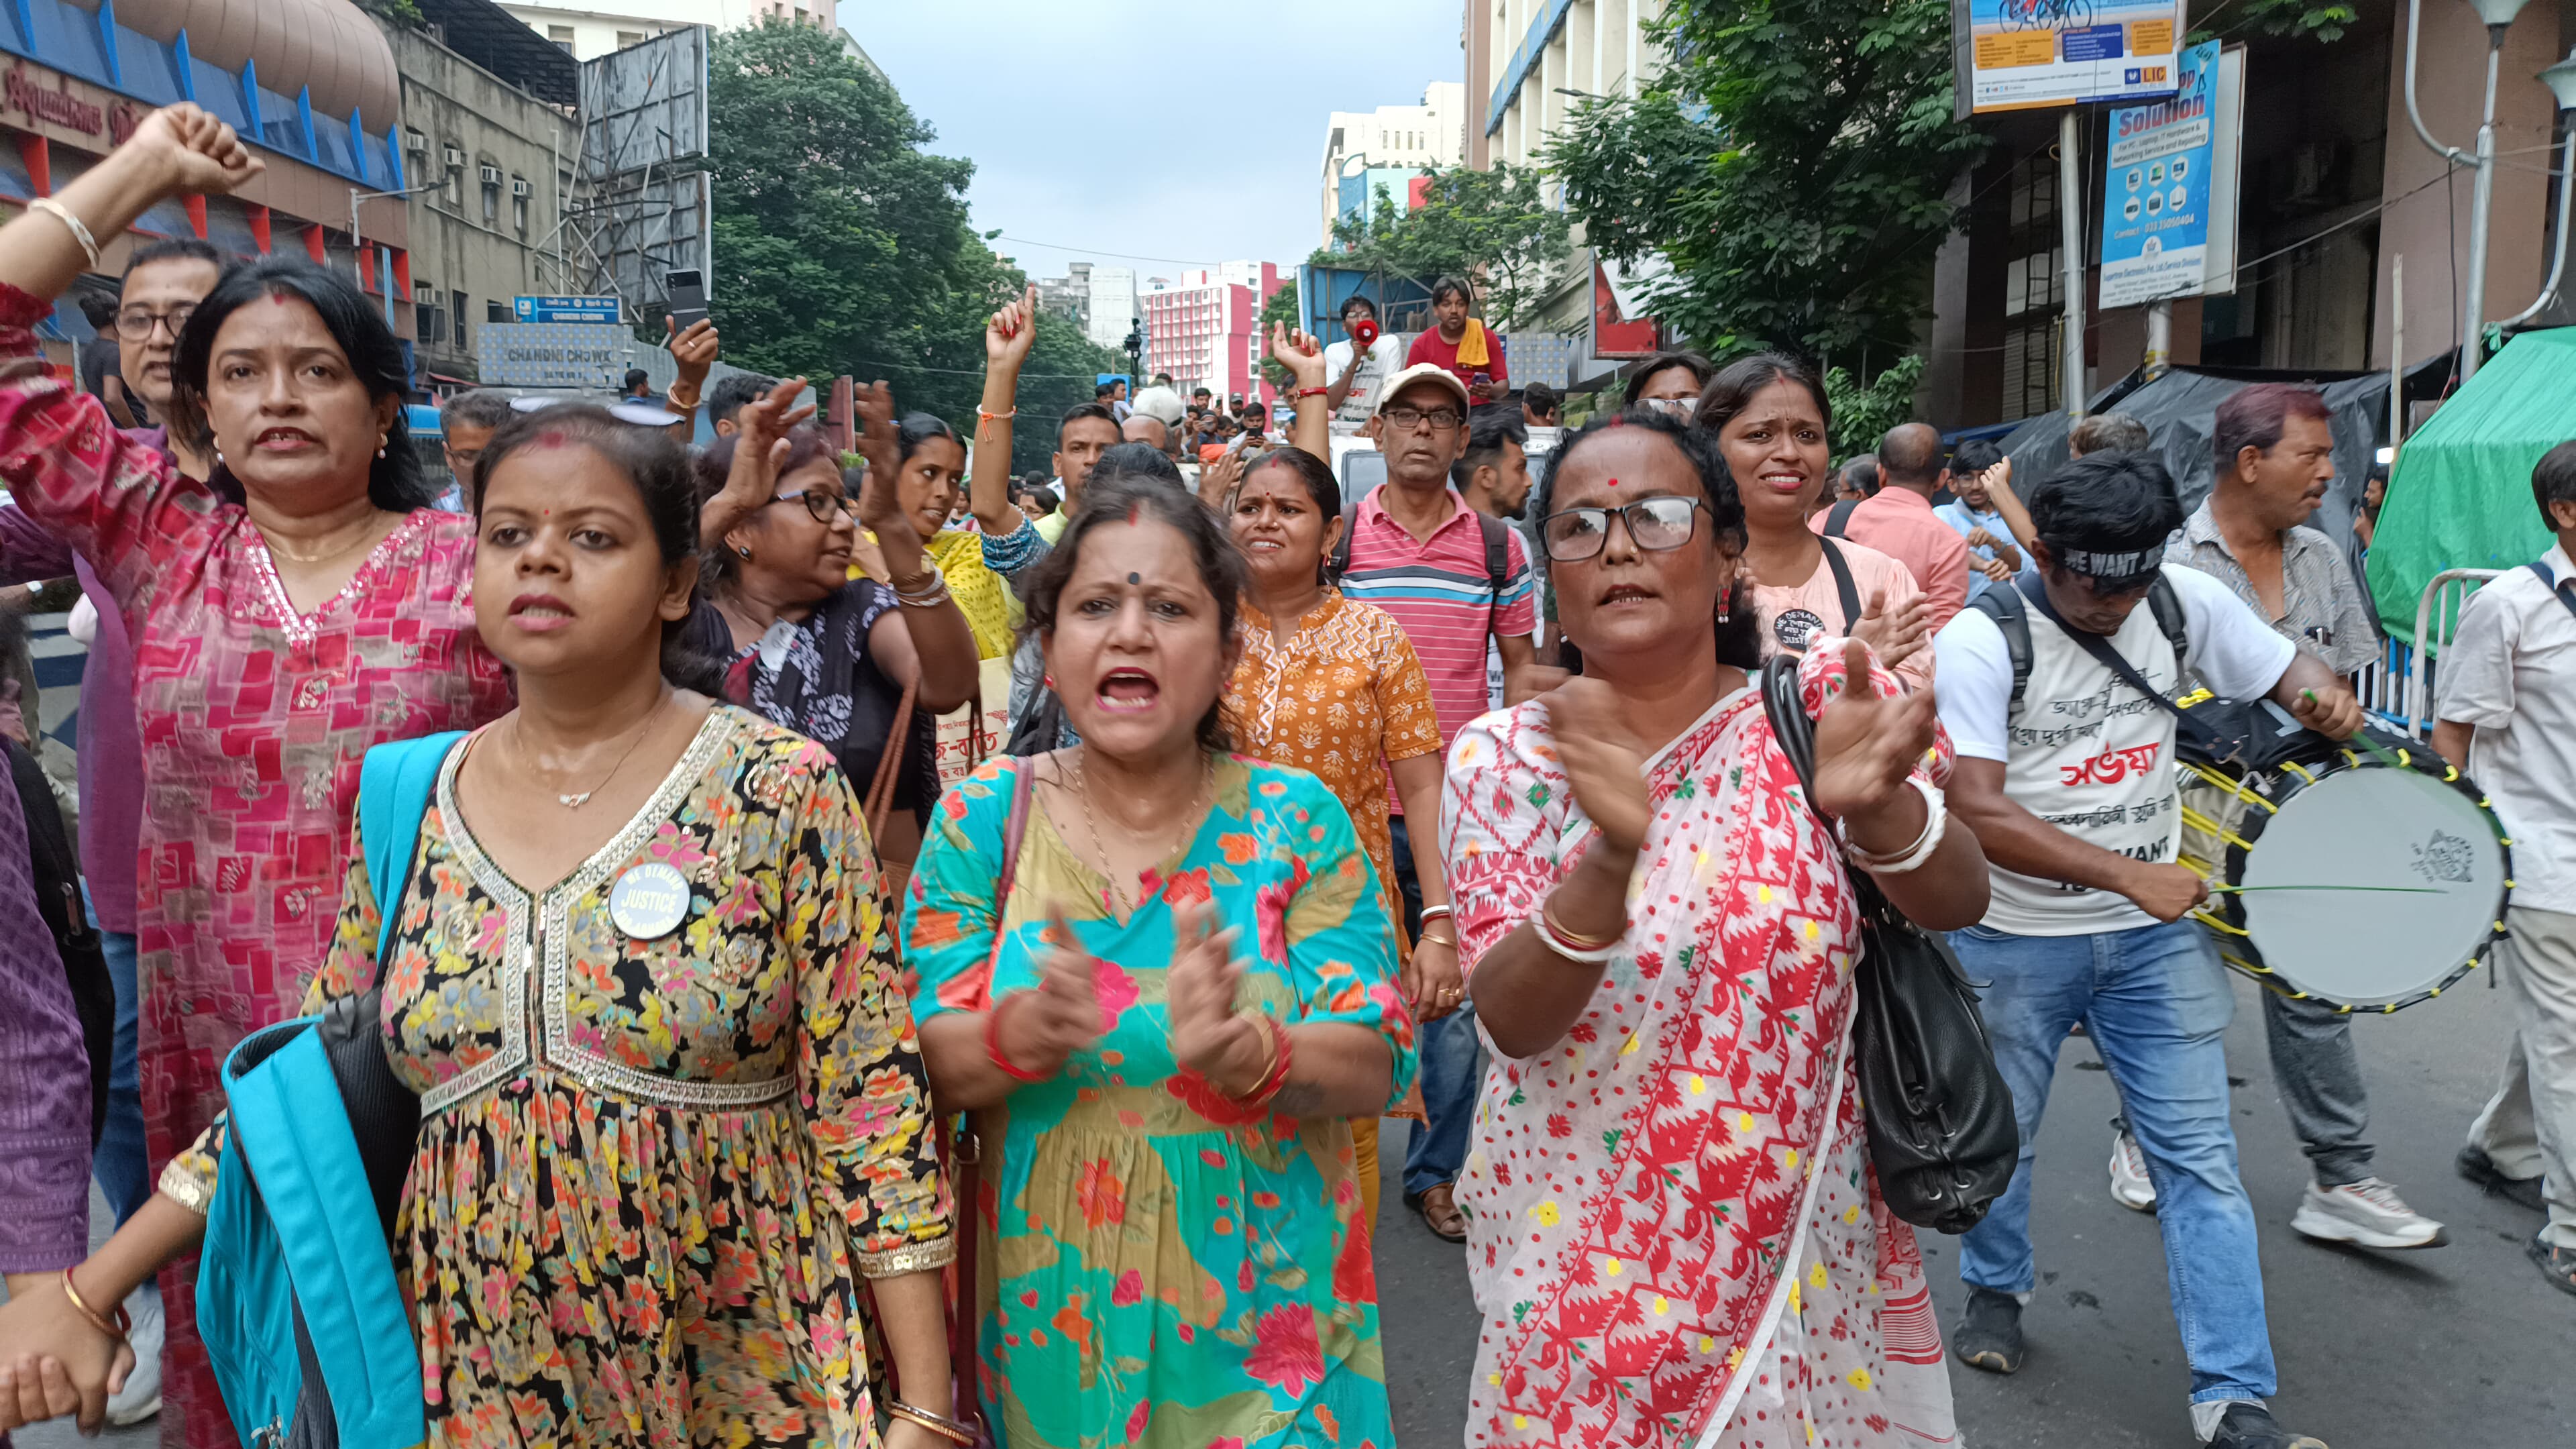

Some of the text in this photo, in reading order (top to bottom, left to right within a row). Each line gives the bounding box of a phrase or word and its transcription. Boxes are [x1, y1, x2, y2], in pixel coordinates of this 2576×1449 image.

[2143, 67, 2164, 83] LIC
[2118, 94, 2205, 137] Solution
[2064, 547, 2088, 572] WE
[2090, 551, 2141, 578] WANT
[1775, 611, 1824, 630] WE DEMAND
[645, 865, 684, 892] DEMAND
[620, 889, 678, 914] JUSTICE
